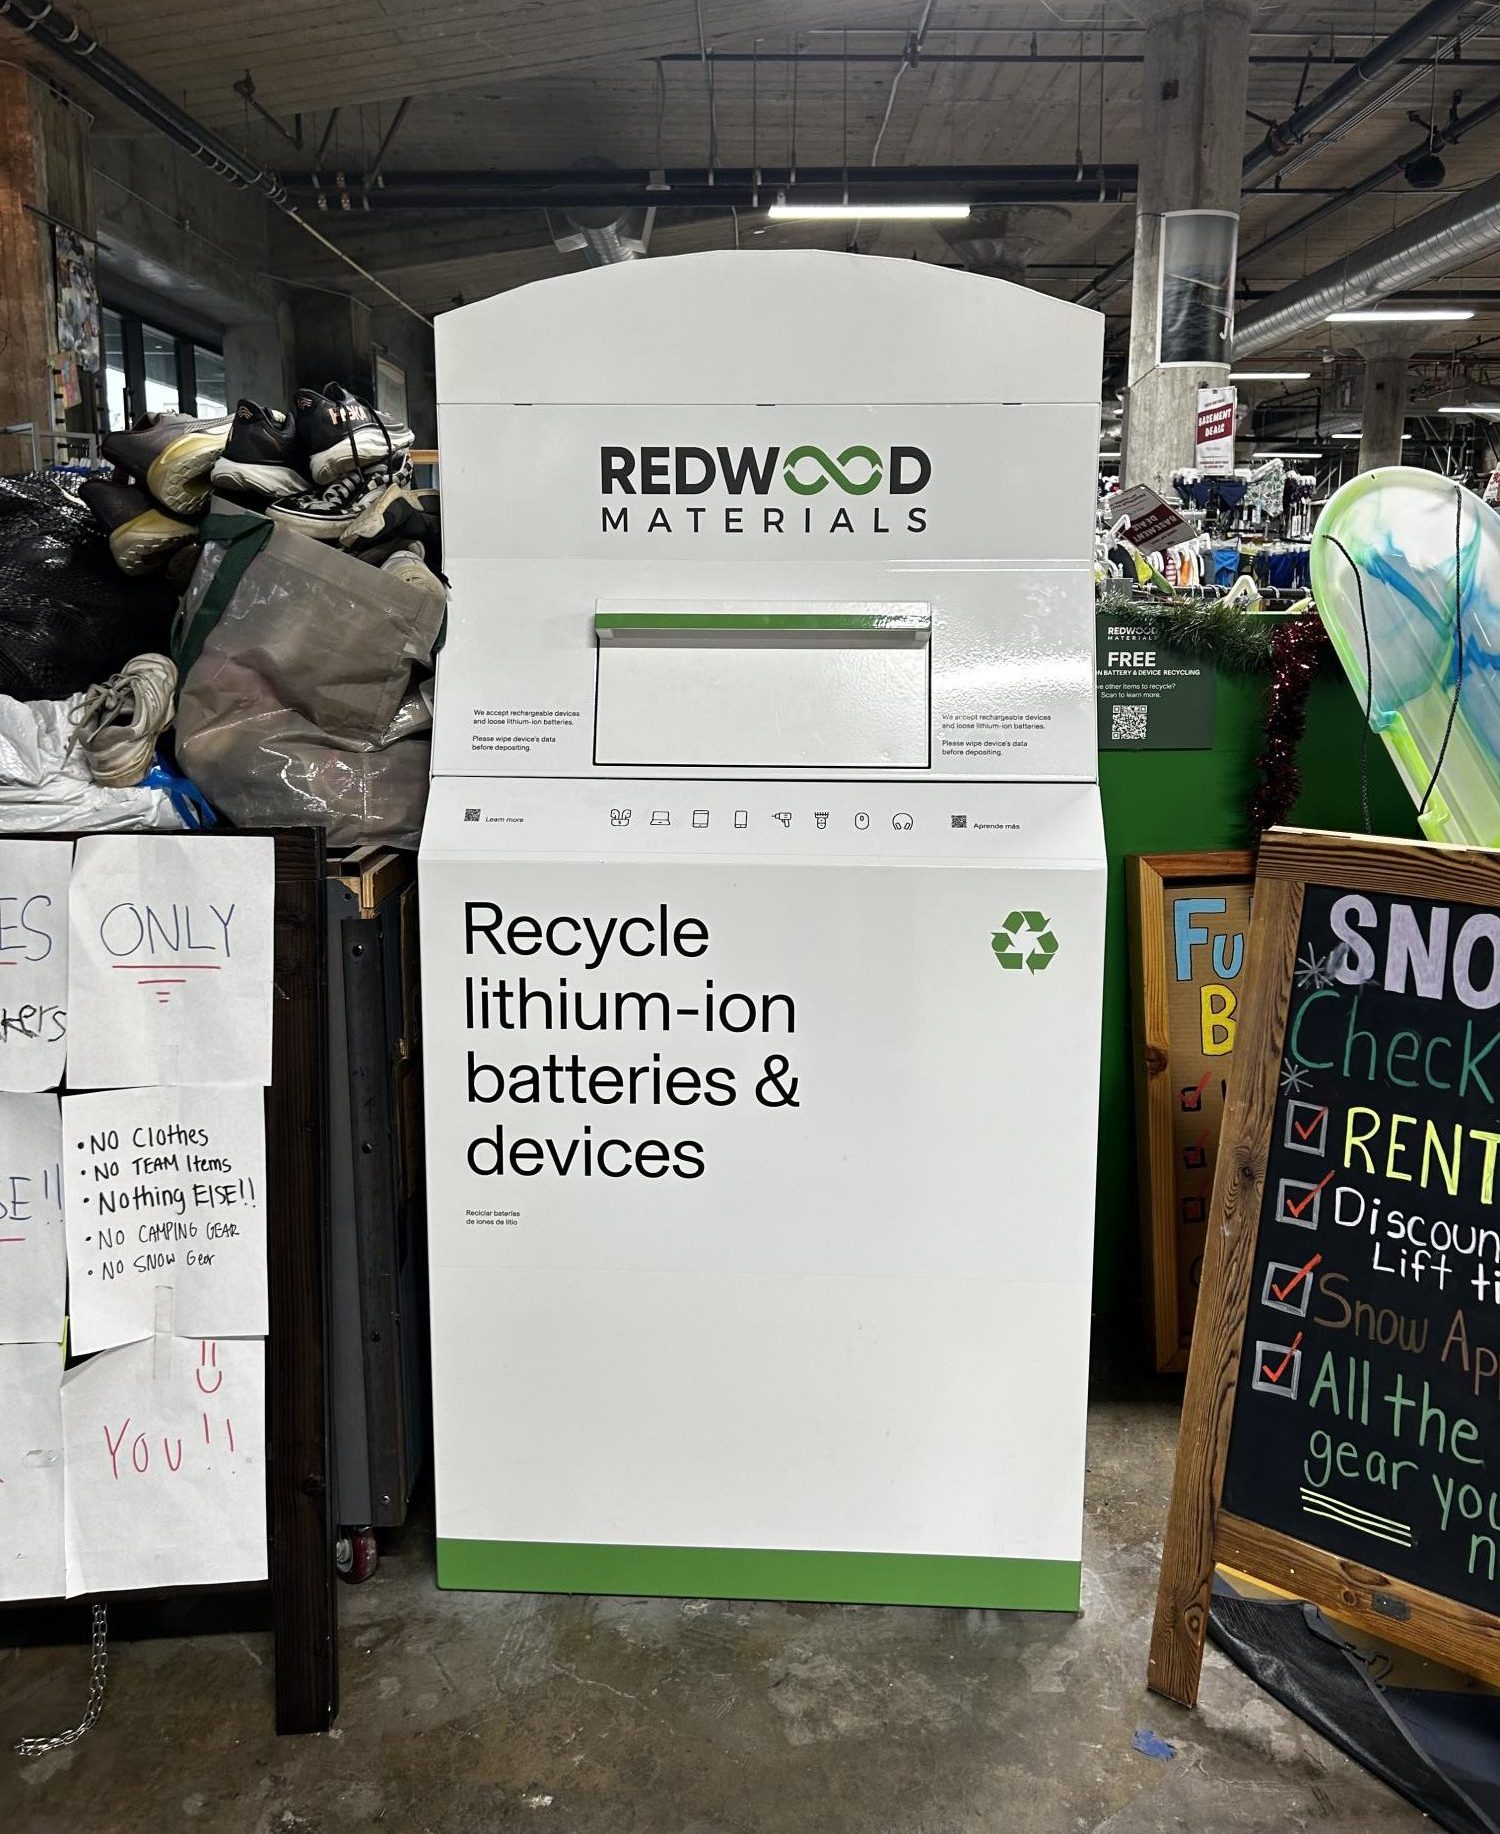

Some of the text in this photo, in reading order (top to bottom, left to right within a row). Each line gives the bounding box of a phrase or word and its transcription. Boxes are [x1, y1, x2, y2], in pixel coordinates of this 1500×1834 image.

[600, 445, 931, 496] REDWOOD
[602, 507, 927, 533] MATERIALS
[1107, 651, 1157, 667] FREE
[1100, 691, 1118, 699] Scan
[1149, 682, 1176, 691] recycle?
[486, 709, 509, 717] accept
[510, 709, 553, 718] rechargeable
[965, 740, 982, 748] wipe
[100, 902, 235, 957] ONLY
[464, 901, 709, 970] Recycle
[1173, 895, 1254, 982] Fu
[465, 976, 796, 1034] lithium-ion
[467, 1050, 800, 1108] batteries &
[90, 1124, 209, 1154] NO Clothes
[466, 1124, 706, 1179] devices
[94, 1154, 232, 1181] NO TEAM Items
[99, 1185, 186, 1215] Nothing
[99, 1221, 240, 1250] NO CAMPING GEAR
[102, 1260, 124, 1280] NO
[1373, 1241, 1453, 1290] Lift
[1313, 1272, 1500, 1396] Snow Ap
[1309, 1350, 1485, 1466] All the
[1303, 1429, 1420, 1491] gear
